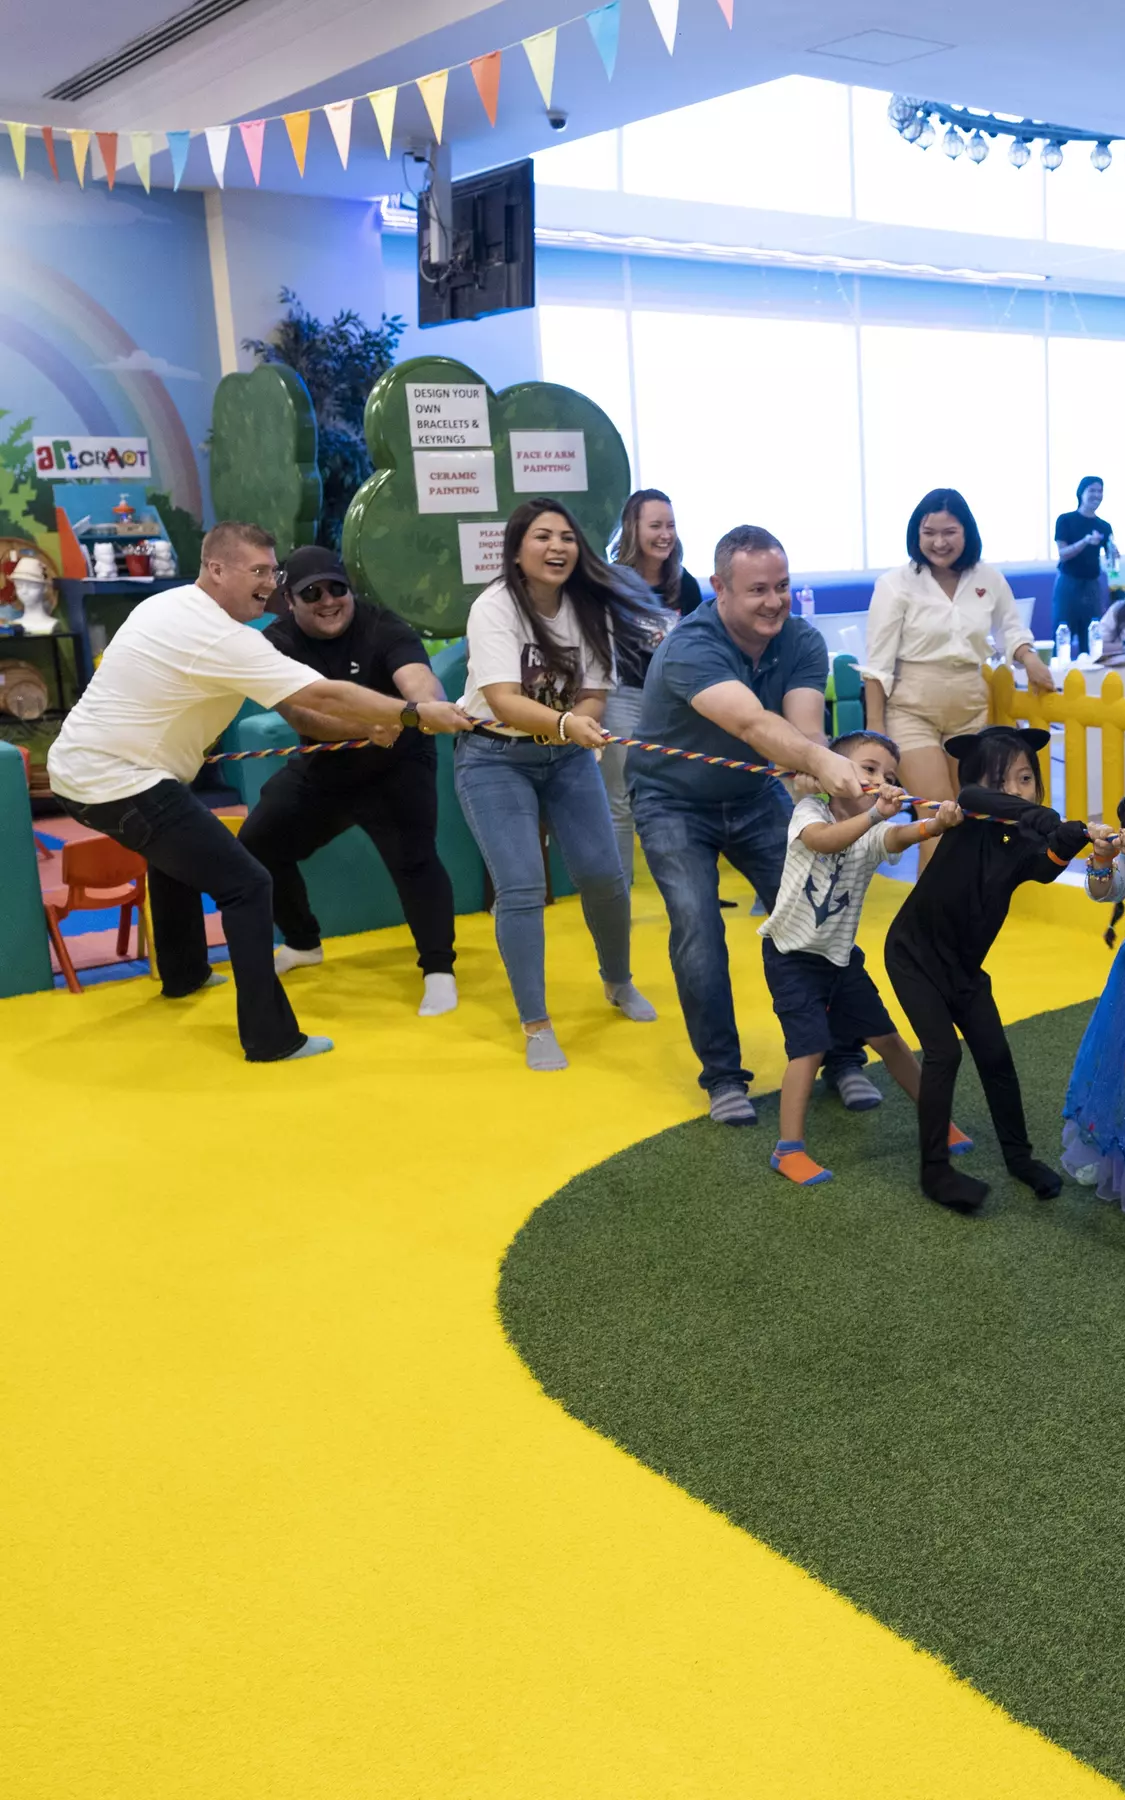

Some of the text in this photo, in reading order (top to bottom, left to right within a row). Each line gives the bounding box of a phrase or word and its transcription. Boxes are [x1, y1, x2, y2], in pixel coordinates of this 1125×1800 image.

[414, 388, 480, 398] DESIGN YOUR
[415, 404, 441, 414] OWN
[417, 419, 480, 429] BRACELETS &
[418, 435, 466, 445] KEYRINGS
[516, 450, 542, 459] FACE
[554, 450, 576, 459] ARM
[523, 464, 571, 473] PAINTING
[430, 471, 477, 480] CERAMIC
[429, 486, 480, 496] PAINTING
[483, 552, 493, 560] AT
